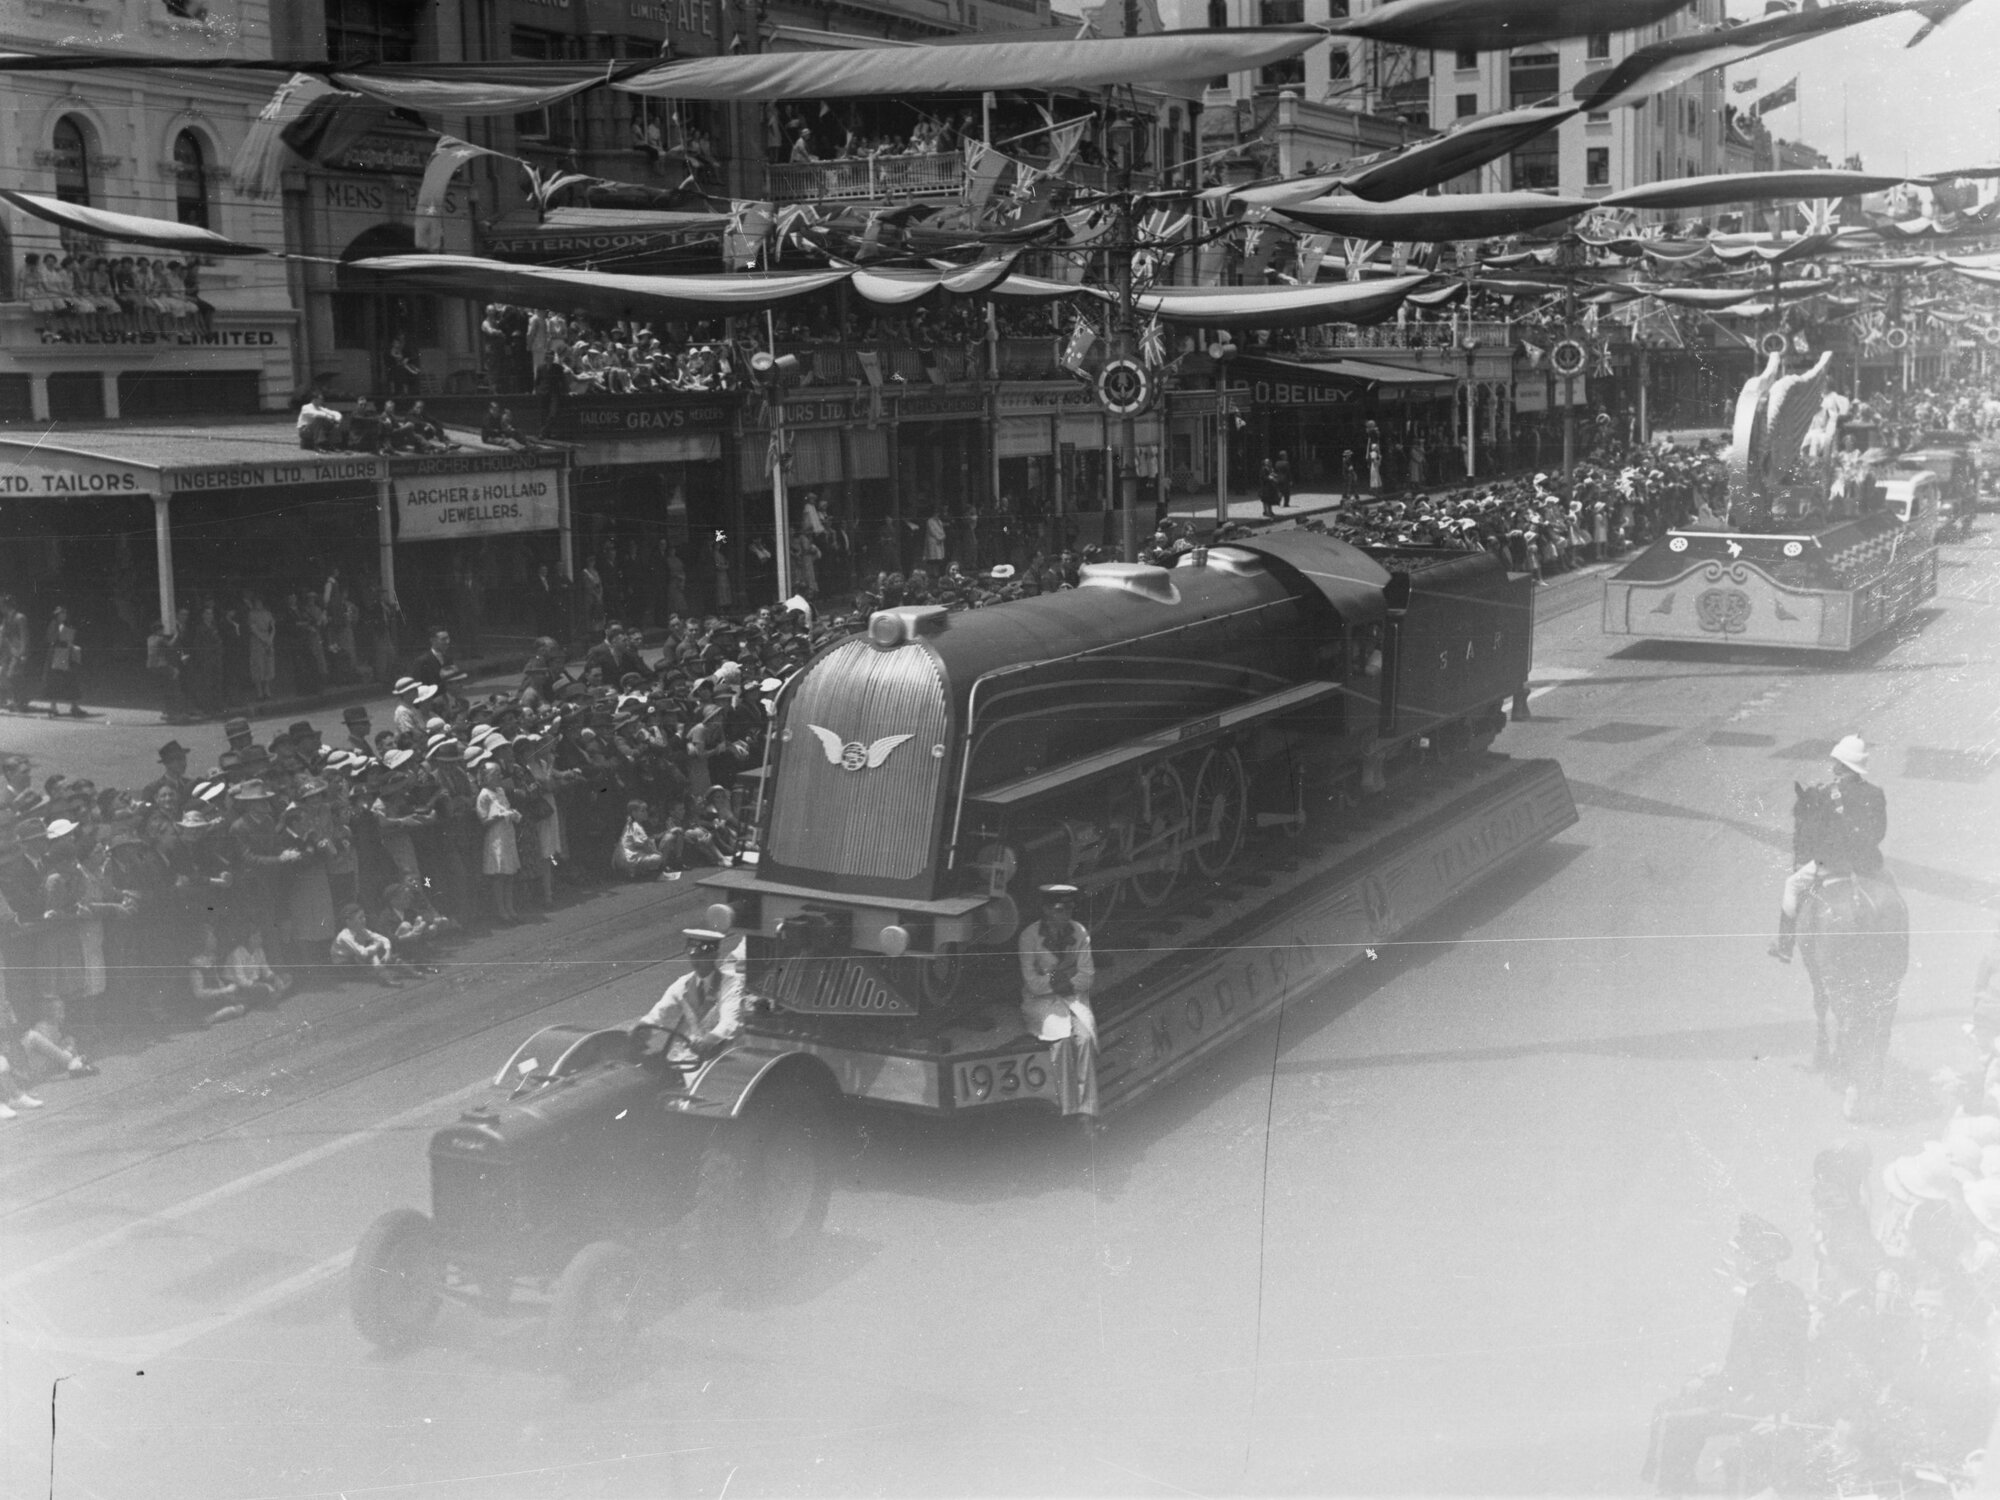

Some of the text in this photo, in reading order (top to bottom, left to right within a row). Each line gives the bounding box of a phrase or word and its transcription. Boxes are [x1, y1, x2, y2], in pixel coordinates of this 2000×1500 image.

[326, 184, 457, 214] MENS BS
[493, 234, 648, 252] AFTERNOON
[627, 410, 685, 429] GRAYS
[820, 402, 846, 421] LTD.
[851, 400, 889, 417] CAE
[417, 458, 470, 474] ARCHER
[482, 454, 537, 471] HOLLAND
[41, 474, 140, 492] TAILORS.
[174, 464, 266, 491] INGERSON
[273, 466, 305, 484] LTD.
[313, 462, 377, 481] TAILORS
[407, 482, 547, 506] ARCHER & HOLLAND
[438, 503, 523, 524] JEWELLERS.
[960, 1055, 1047, 1101] 1936
